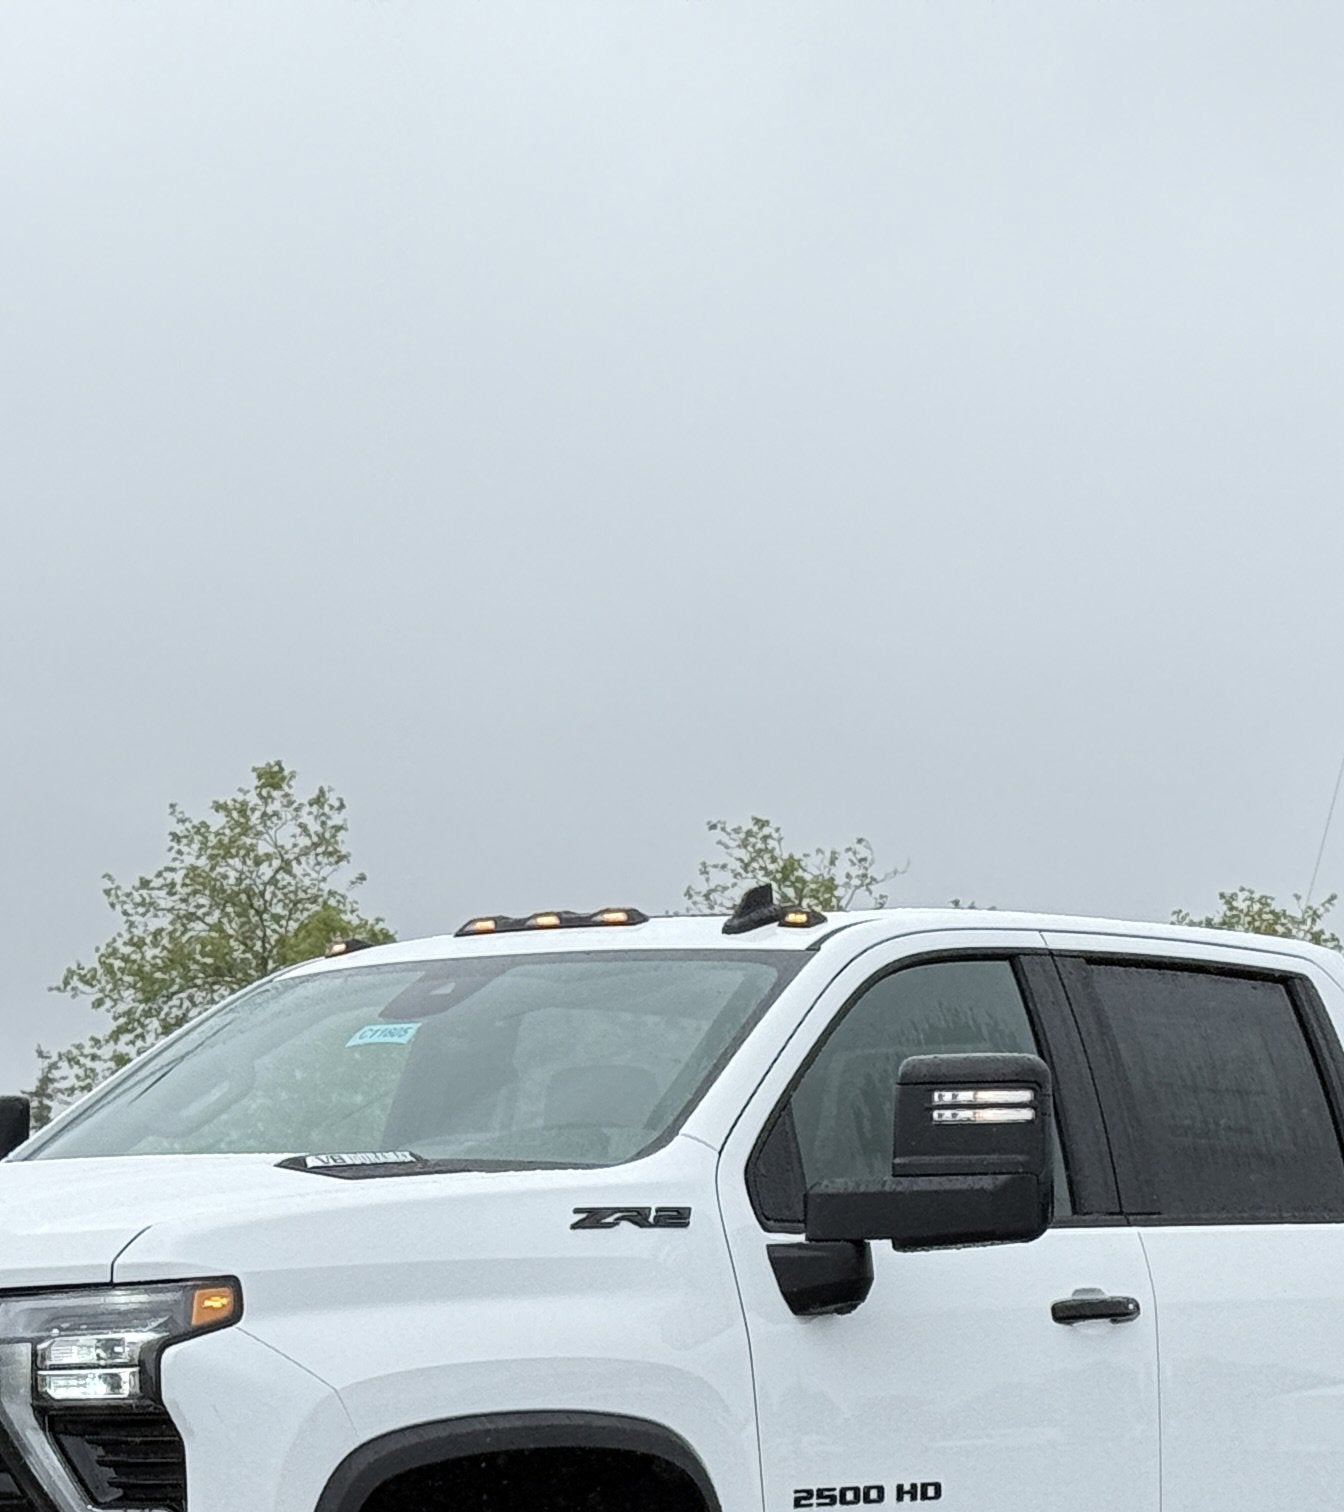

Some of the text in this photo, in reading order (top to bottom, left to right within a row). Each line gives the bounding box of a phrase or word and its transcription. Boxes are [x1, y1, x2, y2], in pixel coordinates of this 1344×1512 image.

[569, 1206, 692, 1229] ZR2
[793, 1481, 942, 1509] 2500 HD
